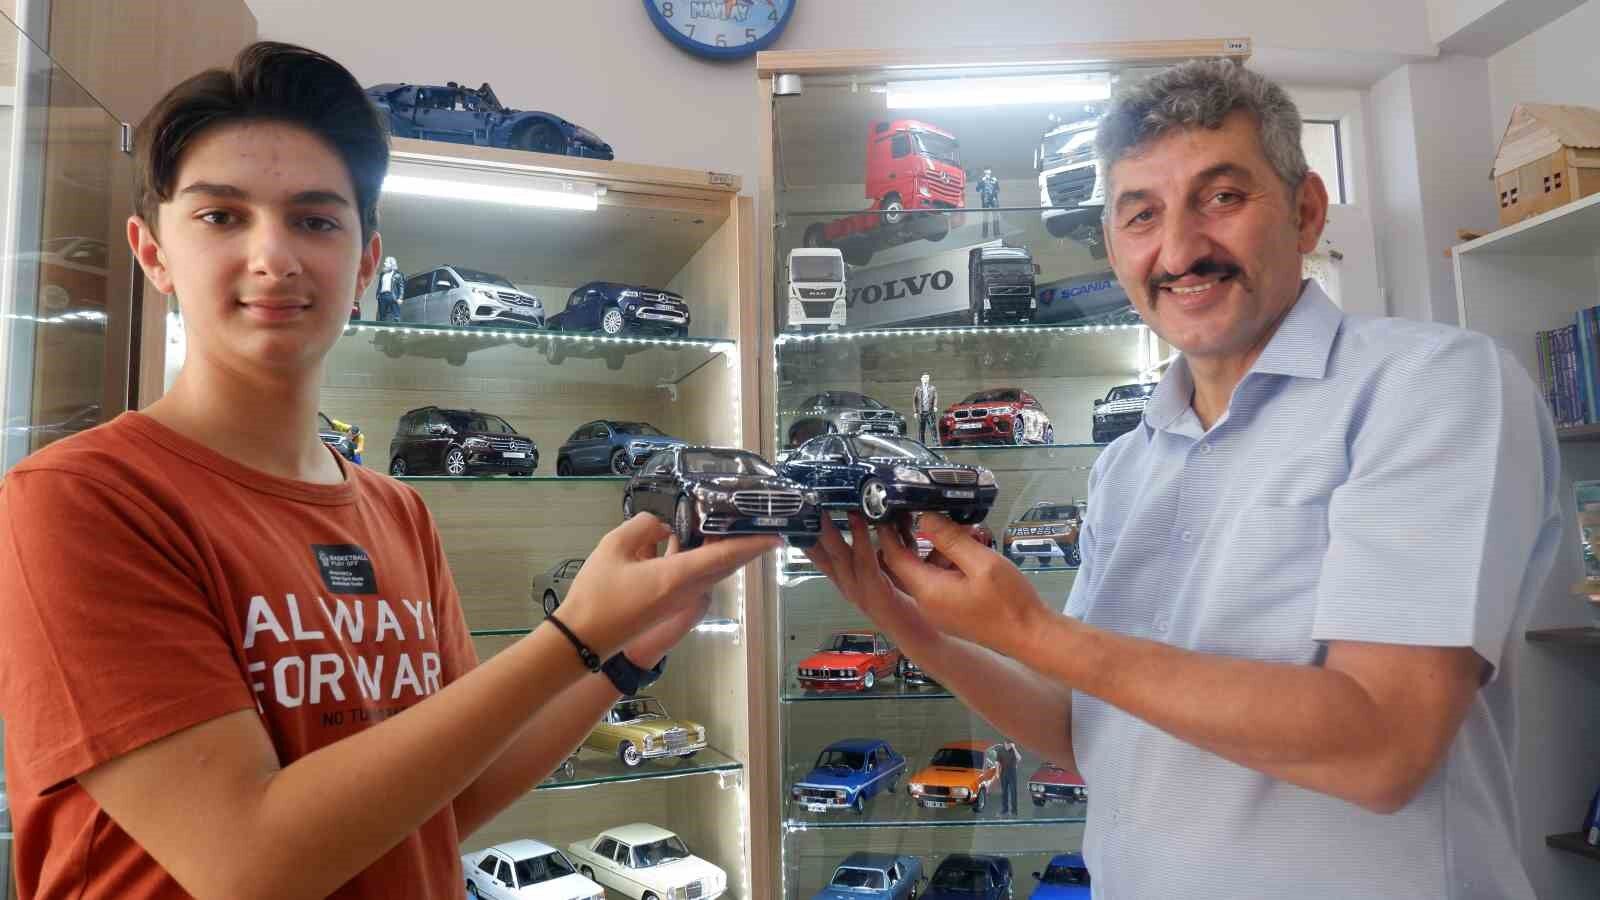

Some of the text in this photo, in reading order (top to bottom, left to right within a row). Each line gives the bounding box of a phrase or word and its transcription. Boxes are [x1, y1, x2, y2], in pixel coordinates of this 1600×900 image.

[662, 2, 674, 18] 8
[768, 8, 779, 21] 4
[685, 24, 696, 39] 7
[745, 28, 757, 42] 5
[715, 34, 727, 47] 6
[1061, 280, 1112, 299] SCANIA
[248, 653, 441, 715] FORWAR
[319, 710, 344, 727] NO
